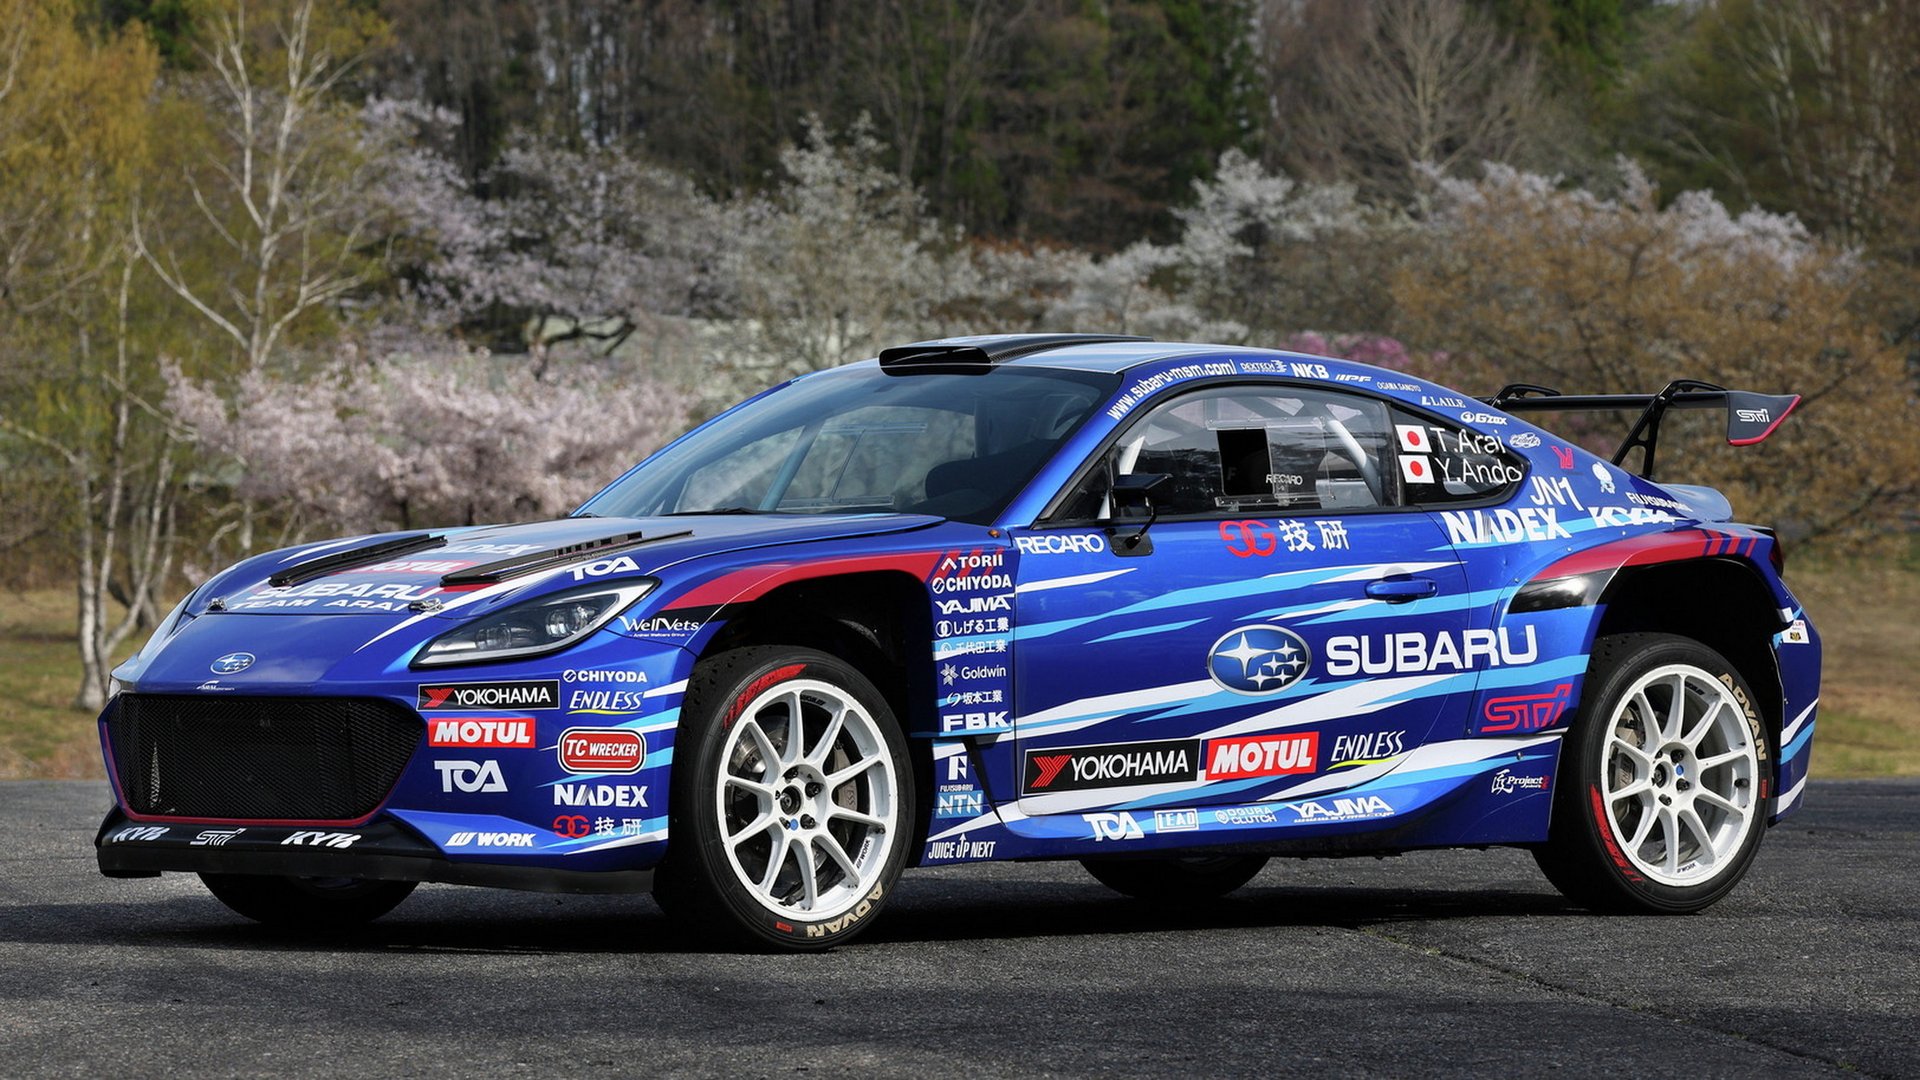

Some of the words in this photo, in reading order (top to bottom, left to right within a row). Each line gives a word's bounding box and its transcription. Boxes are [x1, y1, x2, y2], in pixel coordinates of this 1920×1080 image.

[1290, 363, 1330, 379] NKB
[1429, 427, 1506, 454] T.Arai
[1434, 457, 1523, 484] Y.Ando
[1530, 476, 1584, 511] JN1
[1440, 507, 1572, 545] NADEX
[1014, 534, 1104, 555] RECARO
[566, 556, 640, 581] TOA
[958, 554, 1003, 569] TORII
[247, 583, 444, 601] SUBARU
[946, 574, 1012, 593] CHIYODA
[231, 599, 318, 609] TEAM
[323, 599, 409, 612] ARAI
[935, 597, 1011, 615] YAJIMA
[953, 617, 1009, 635] しげる工業
[1326, 624, 1537, 676] SUBARU
[577, 670, 647, 683] CHIYODA
[961, 665, 1006, 680] Goldwin
[454, 687, 551, 706] YOKOHAMA
[569, 690, 645, 710] ENDLESS
[943, 711, 1012, 732] FBK
[1718, 673, 1767, 761] ADVAN
[434, 721, 531, 743] MOTUL
[566, 739, 587, 757] TC
[589, 742, 638, 757] WRECKER
[1211, 737, 1313, 775] MOTUL
[1331, 729, 1406, 763] ENDLESS
[1071, 749, 1189, 782] YOKOHAMA
[434, 760, 508, 793] TOA
[553, 785, 648, 808] NADEX
[938, 793, 981, 816] NTN
[1284, 796, 1394, 818] YAJIMA
[1082, 811, 1145, 841] TOA
[1231, 814, 1277, 825] CLUTCH
[112, 826, 170, 843] KYB
[280, 831, 362, 849] KYB
[475, 832, 536, 847] WORK
[928, 842, 955, 859] JUICE
[970, 841, 996, 858] NEXT
[807, 881, 883, 937] ADVAN
